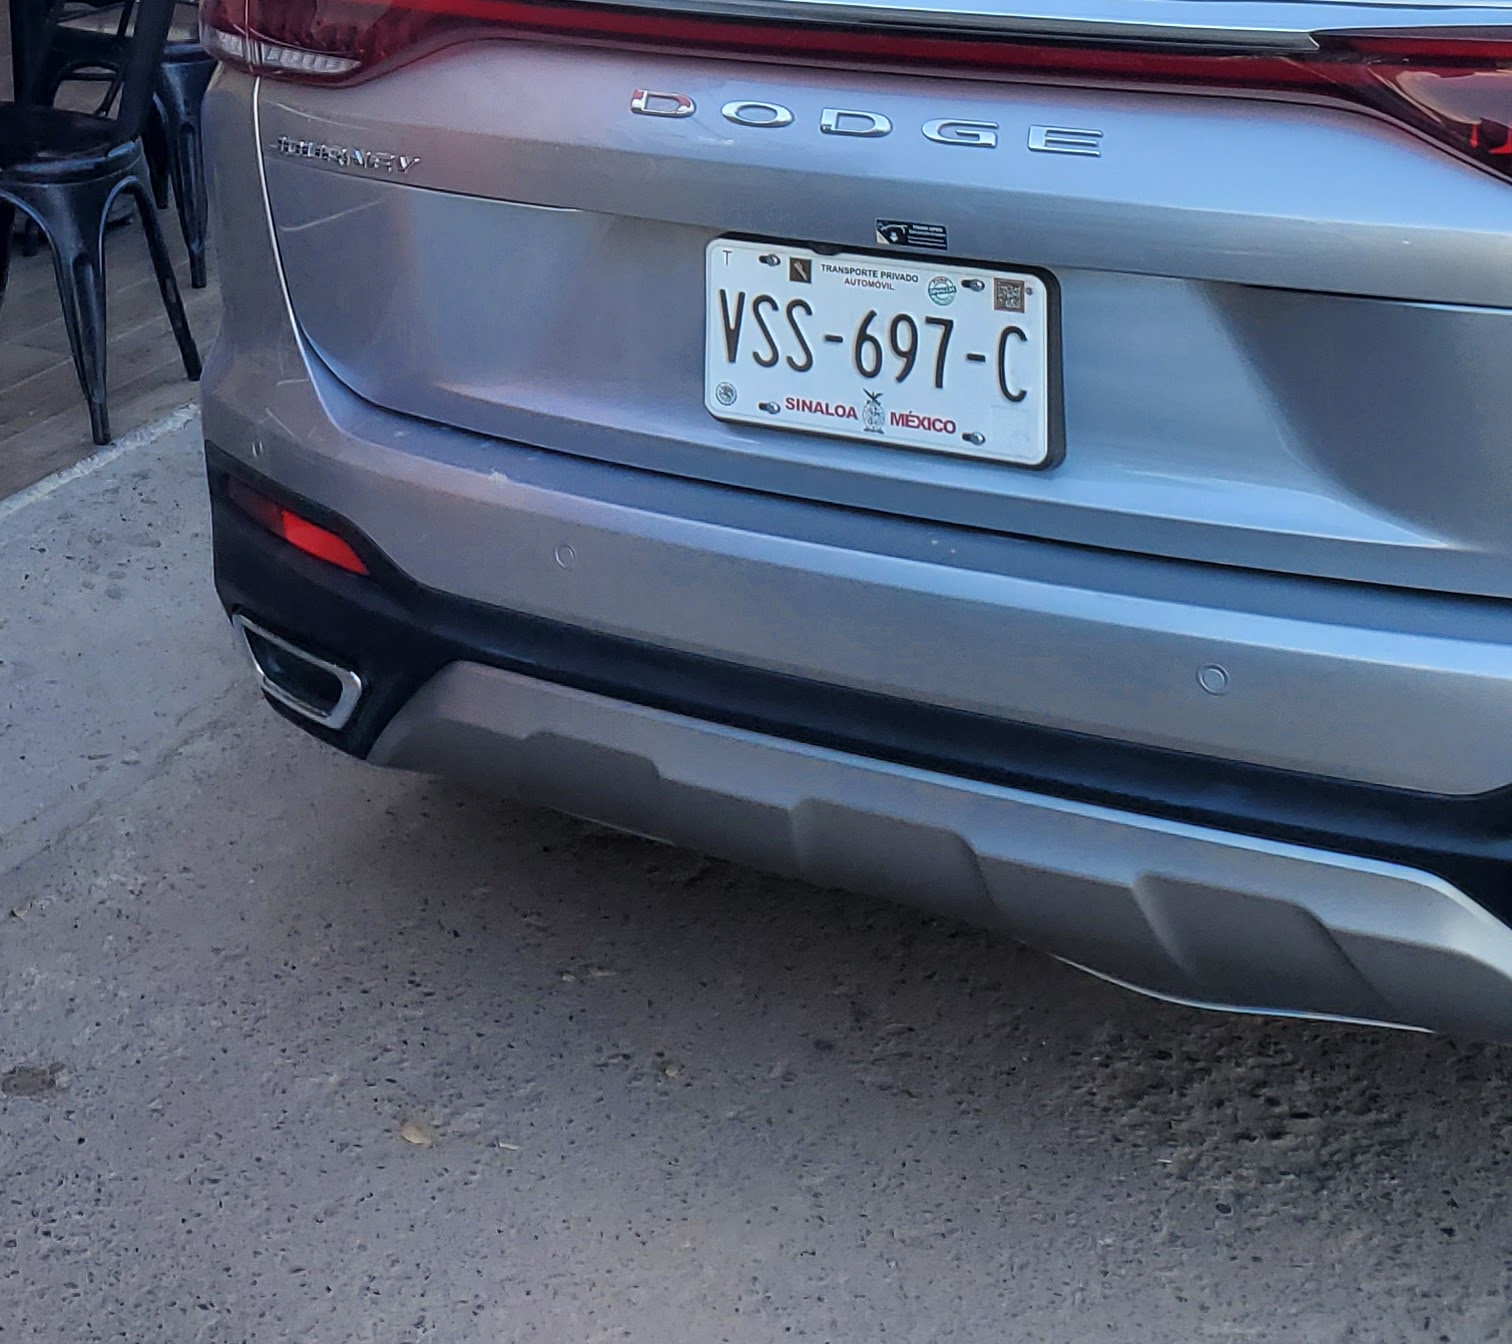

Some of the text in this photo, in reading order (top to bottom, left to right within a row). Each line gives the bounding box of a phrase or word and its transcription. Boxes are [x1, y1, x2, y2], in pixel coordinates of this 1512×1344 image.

[630, 88, 1104, 158] DODGE
[820, 263, 919, 283] TRANSPORTE PRIVADO
[844, 277, 895, 291] AUTOMÓVIL
[719, 288, 1029, 404] VSS-697-C
[785, 397, 957, 434] SINALOA MÉXICO
